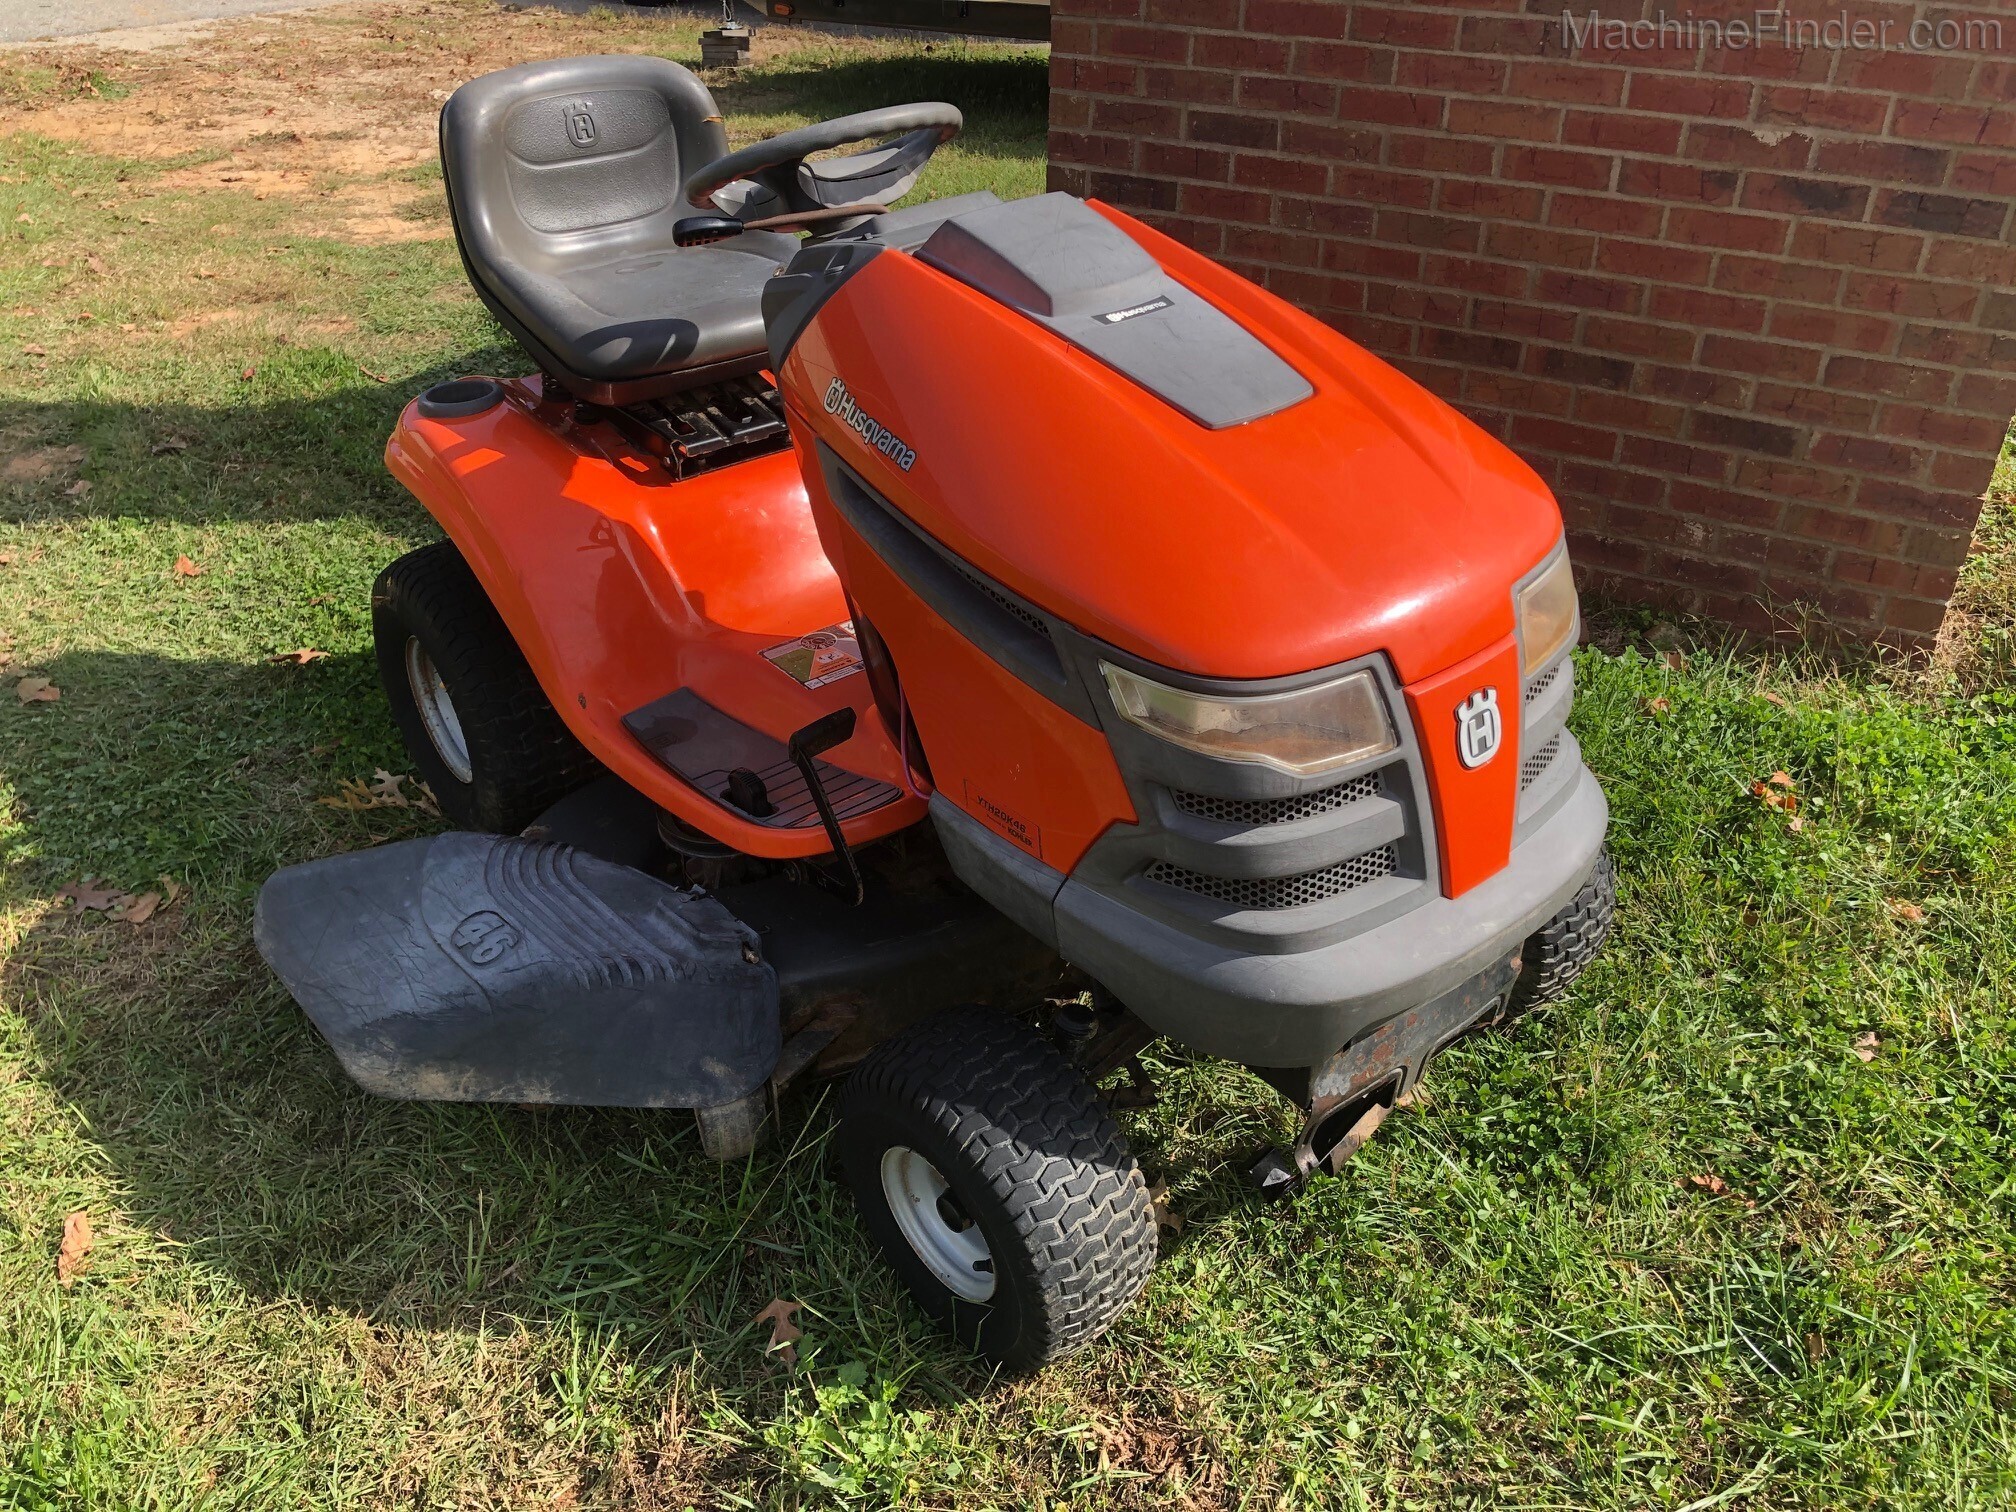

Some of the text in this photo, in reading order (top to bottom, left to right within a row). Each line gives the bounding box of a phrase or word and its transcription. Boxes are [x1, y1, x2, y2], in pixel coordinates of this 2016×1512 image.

[1120, 301, 1167, 319] Husqvarna
[836, 391, 917, 472] Husqvarna
[455, 921, 517, 965] 46
